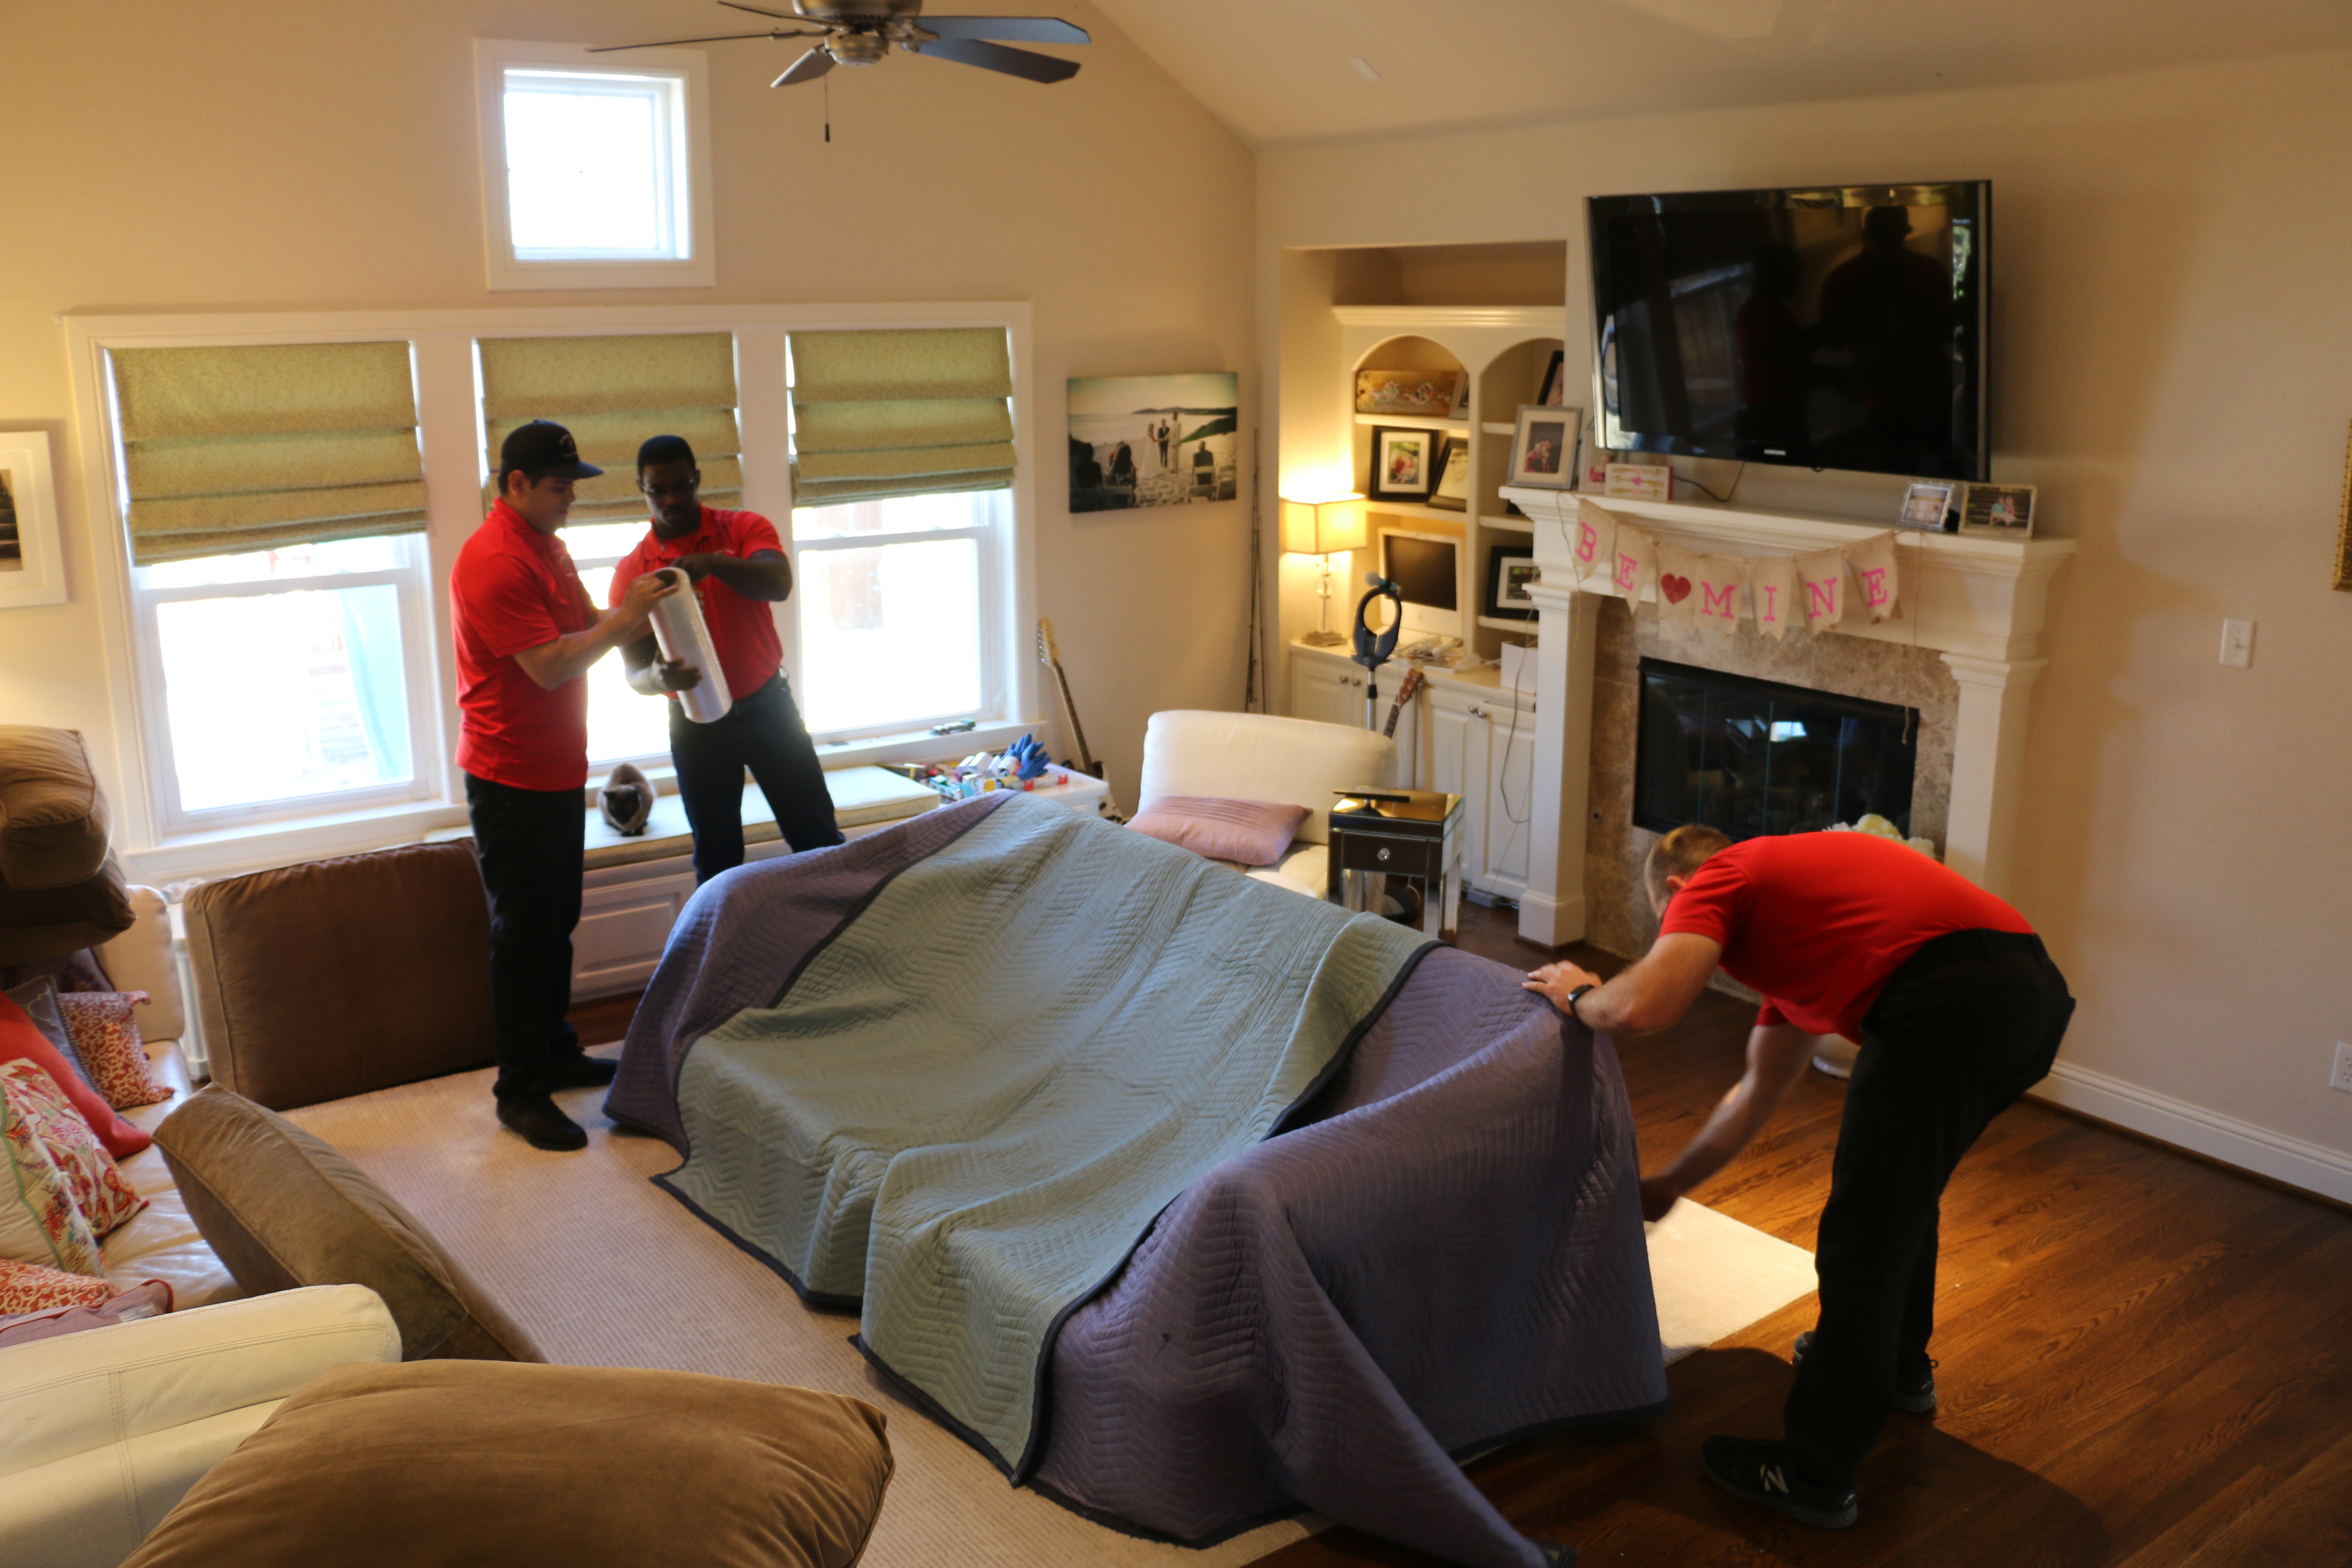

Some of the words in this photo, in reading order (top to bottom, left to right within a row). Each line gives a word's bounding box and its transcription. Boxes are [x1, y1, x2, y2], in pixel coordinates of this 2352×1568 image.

[1575, 521, 1637, 591] BE
[1701, 567, 1888, 622] MINE
[1760, 1464, 1789, 1494] N
